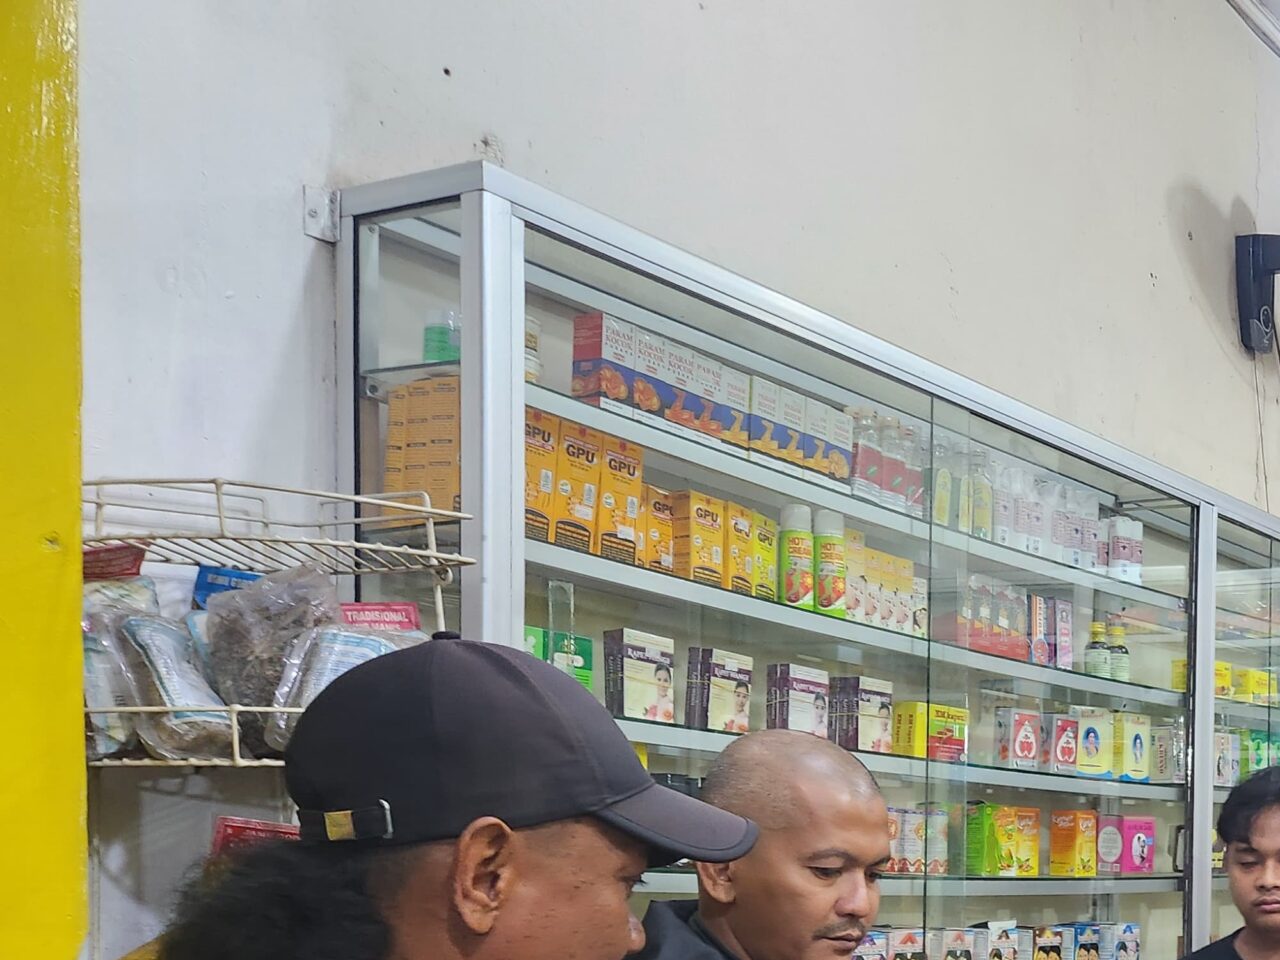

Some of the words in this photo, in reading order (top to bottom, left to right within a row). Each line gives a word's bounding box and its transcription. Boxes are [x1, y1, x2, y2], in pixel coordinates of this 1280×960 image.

[566, 444, 595, 464] GPU
[608, 458, 636, 477] GPU
[696, 506, 719, 523] GPU
[757, 530, 773, 547] GPU
[346, 610, 409, 622] TRADISIONAL
